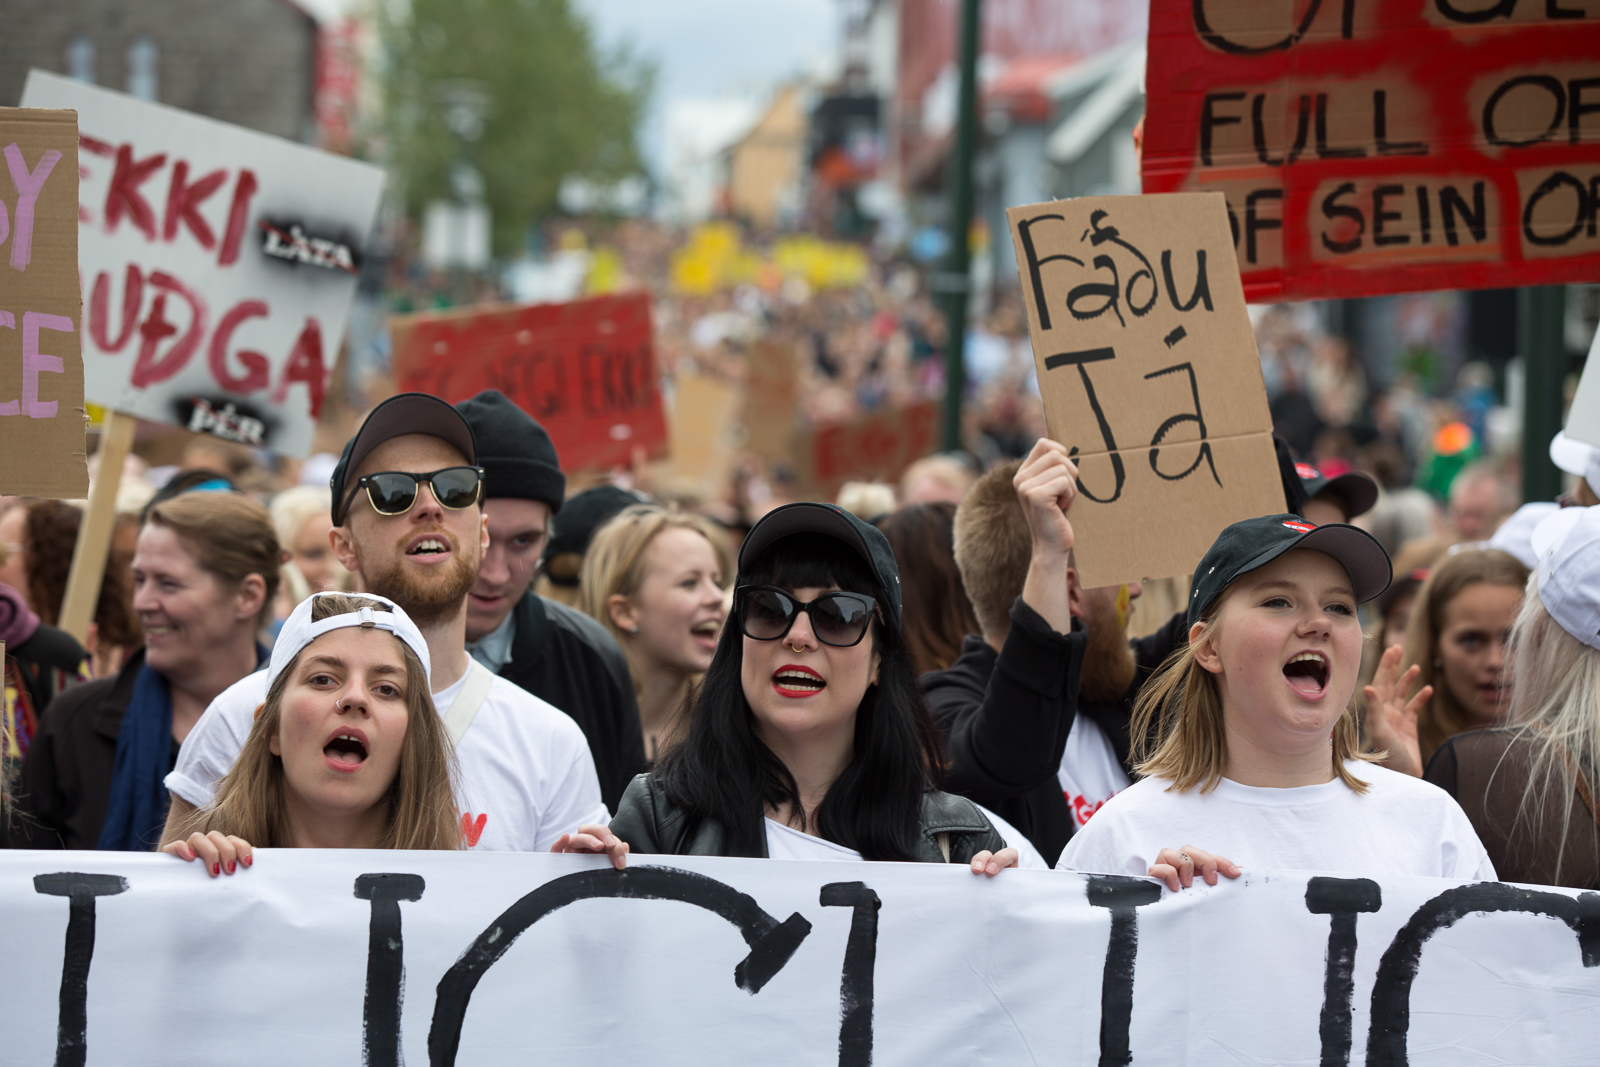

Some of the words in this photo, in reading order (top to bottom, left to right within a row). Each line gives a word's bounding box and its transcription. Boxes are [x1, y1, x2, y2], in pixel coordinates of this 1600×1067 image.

[1201, 90, 1429, 166] FULL
[1224, 188, 1284, 265] F
[1321, 180, 1487, 254] SEIN
[1044, 325, 1224, 504] Já
